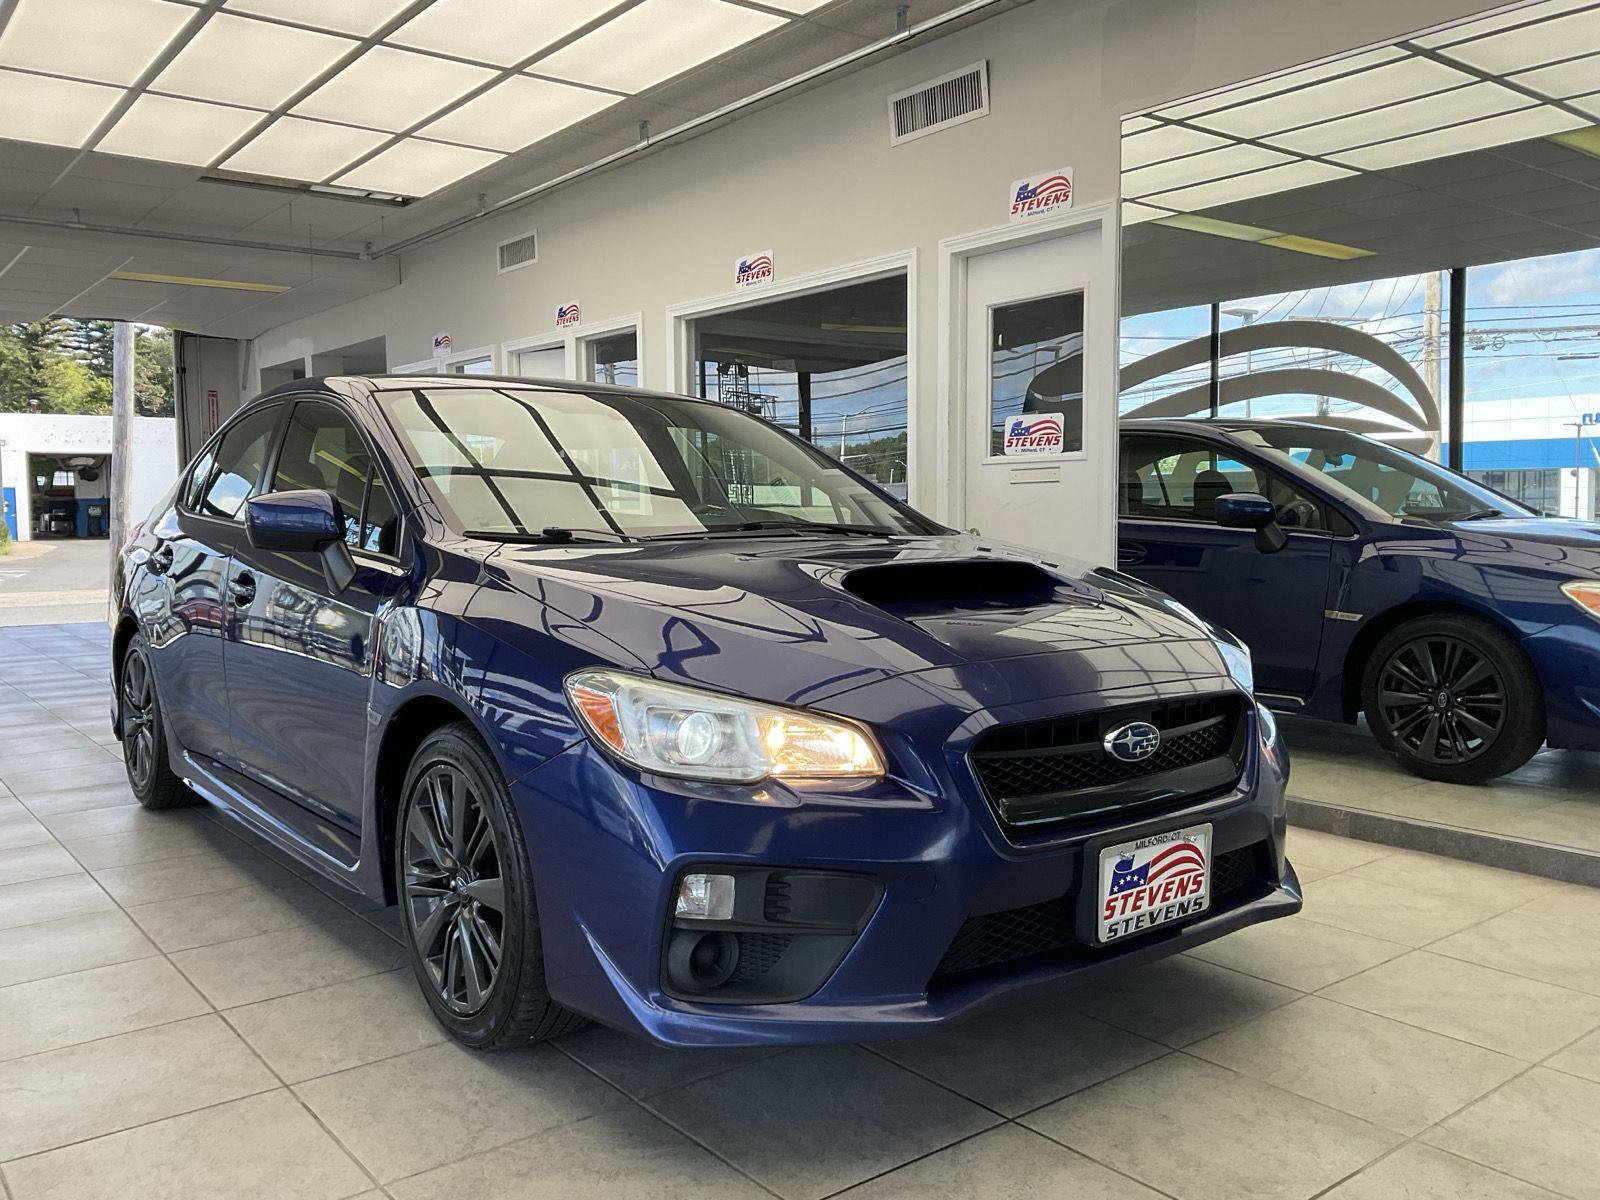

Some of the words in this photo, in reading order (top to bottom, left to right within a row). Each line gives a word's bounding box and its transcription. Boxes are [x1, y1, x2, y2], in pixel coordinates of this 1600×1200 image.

[1011, 190, 1071, 215] STEVENS
[736, 267, 772, 284] STEVENS
[556, 315, 579, 326] STEVENS
[1006, 435, 1062, 448] STEVENS
[1170, 831, 1181, 841] CT
[1103, 872, 1205, 921] STEVENS
[1106, 896, 1204, 940] STEVENS
